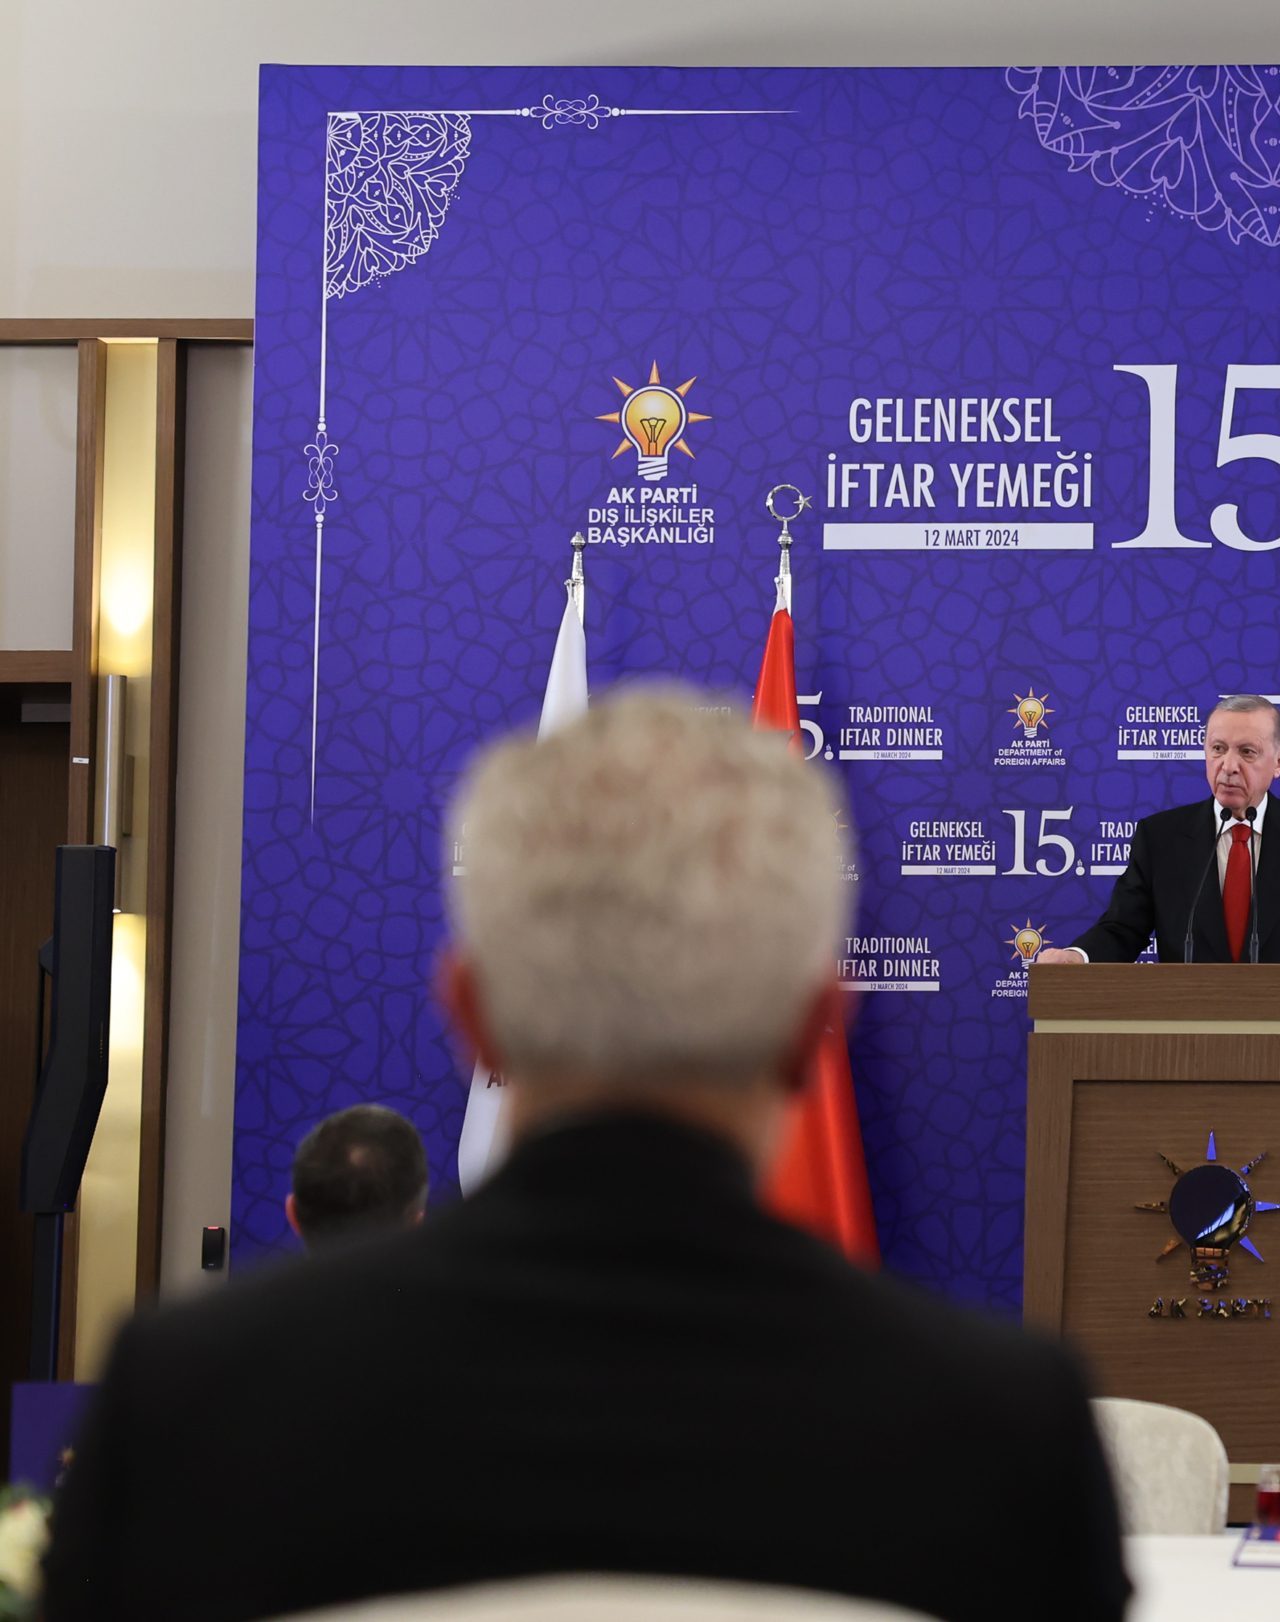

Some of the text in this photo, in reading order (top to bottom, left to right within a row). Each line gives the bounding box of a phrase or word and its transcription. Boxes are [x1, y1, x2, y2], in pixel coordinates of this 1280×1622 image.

[848, 397, 1060, 443] GELENEKSEL
[826, 450, 1093, 507] İFTAR YEMEĞİ
[606, 483, 697, 504] AK PARTİ
[588, 504, 714, 527] DIŞ İLİŞKİLER
[587, 523, 714, 547] BAŞKANLIĞI
[923, 530, 1020, 547] 12 MART 2024
[848, 706, 934, 723] TRADITIONAL
[1126, 706, 1200, 723] GELENEKSEL
[840, 728, 943, 746] IFTAR DINNER
[1011, 740, 1024, 748] AK
[1118, 725, 1205, 746] İFTAR YEMEĞ
[998, 748, 1062, 756] DEPARTMENT of
[994, 758, 1066, 766] FOREIGN AFFAIRS
[910, 821, 984, 838] GELENEKSEL
[1002, 805, 1086, 876] 15.
[902, 840, 996, 861] İFTAR YEMEĞİ
[1091, 843, 1132, 861] IFTAR
[845, 937, 931, 954] TRADITIONAL
[837, 959, 940, 977] IFTAR DINNER
[1009, 971, 1021, 979] AK
[995, 980, 1028, 988] DEPART
